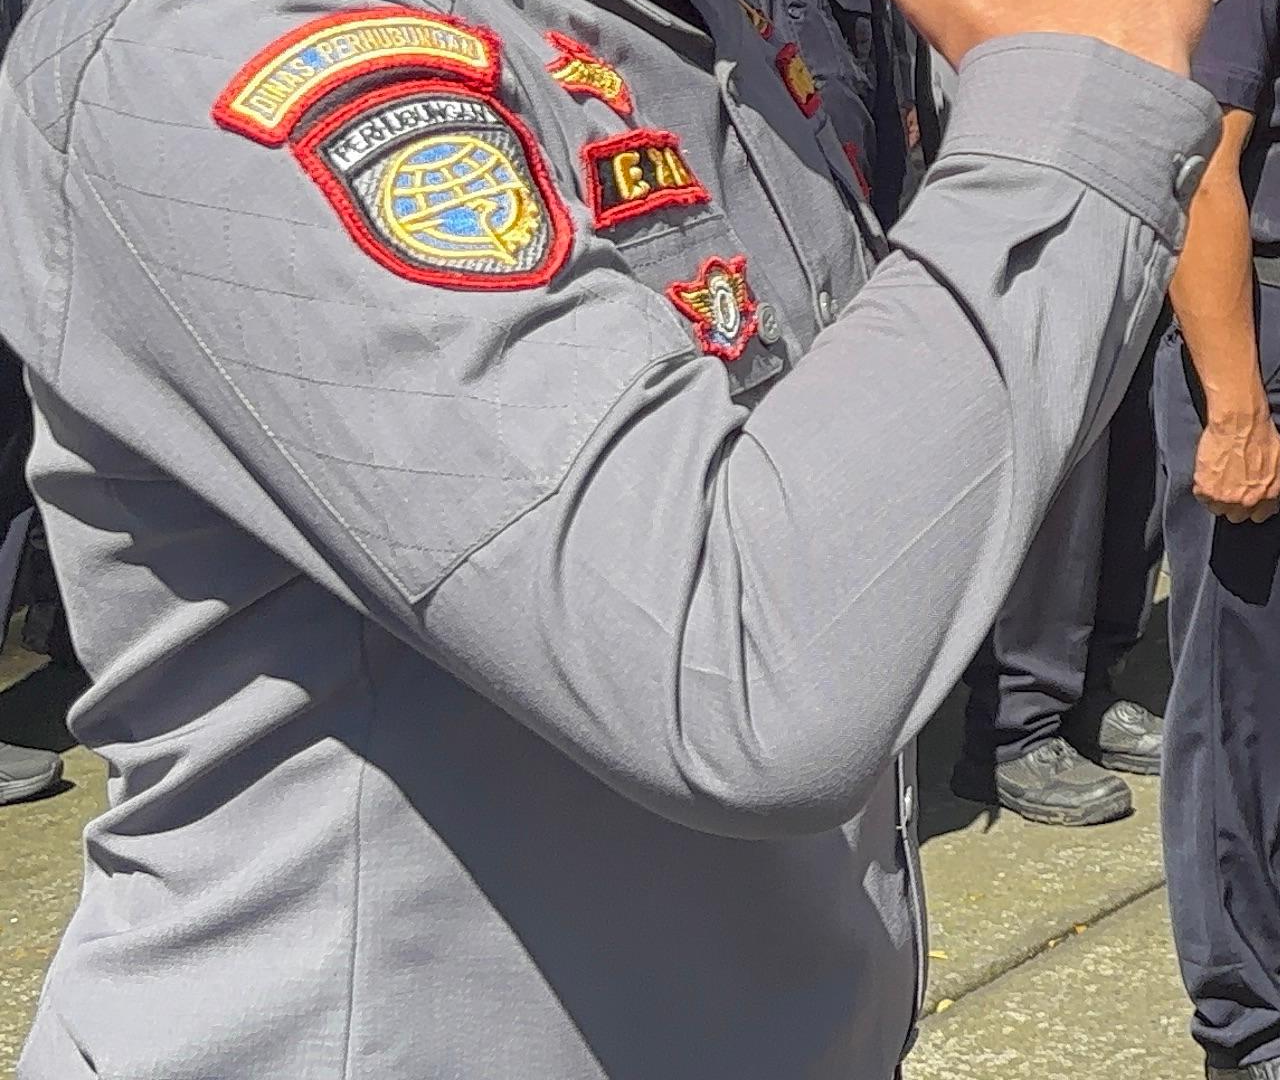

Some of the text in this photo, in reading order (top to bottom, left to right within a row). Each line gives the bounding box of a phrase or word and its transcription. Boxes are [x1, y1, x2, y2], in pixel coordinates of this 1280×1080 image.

[249, 25, 481, 120] DINAS PERHUBUNGAN
[334, 100, 498, 163] PERHUBUNGAN
